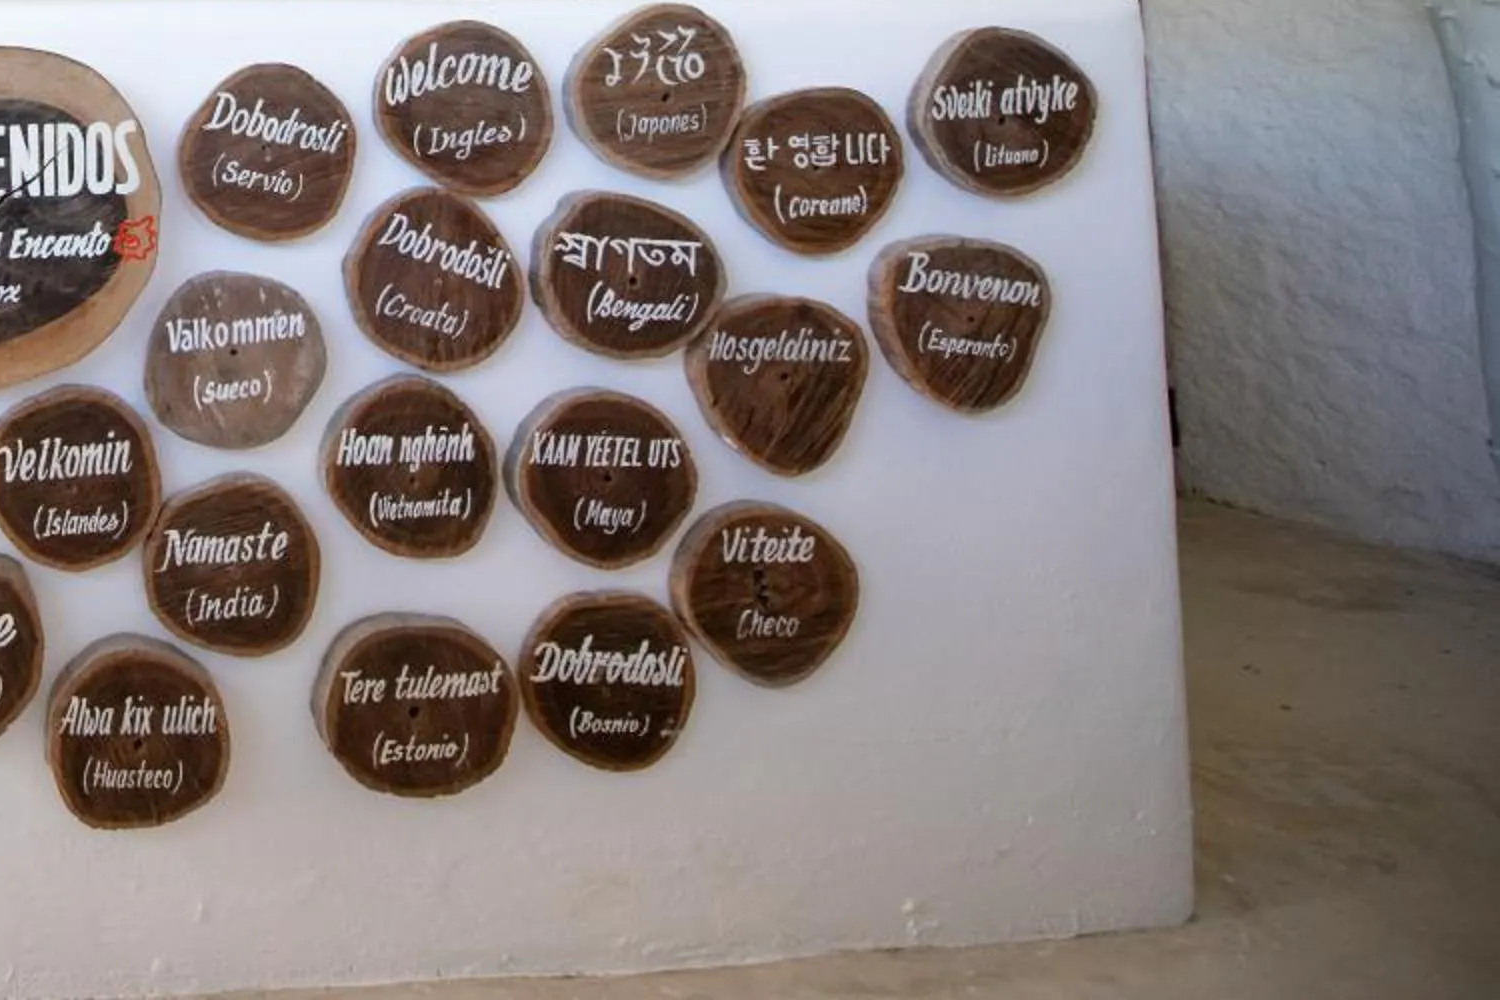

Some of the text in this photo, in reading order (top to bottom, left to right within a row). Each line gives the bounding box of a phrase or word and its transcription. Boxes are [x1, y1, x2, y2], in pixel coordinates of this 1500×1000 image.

[385, 42, 533, 106] Welcome
[617, 103, 707, 142] (Japones)
[212, 153, 304, 202] (Servio)
[9, 222, 112, 260] Encanto
[378, 213, 511, 289] Dobrodošli
[898, 252, 1042, 307] Bonvenon
[376, 282, 469, 339] (Croata)
[587, 280, 700, 332] (Bengali)
[917, 321, 1017, 362] (Esperanto)
[336, 427, 392, 467] Hoan
[648, 438, 683, 469] UTS
[33, 501, 129, 540] (Islandes)
[573, 496, 648, 535] (Maya)
[153, 522, 290, 572] Namaste
[185, 585, 279, 625] (India)
[736, 609, 799, 639] Checo
[340, 662, 504, 703] Tere tulemast
[121, 696, 152, 736] kix
[162, 696, 216, 735] ulich
[83, 756, 182, 794] (Huasteco)
